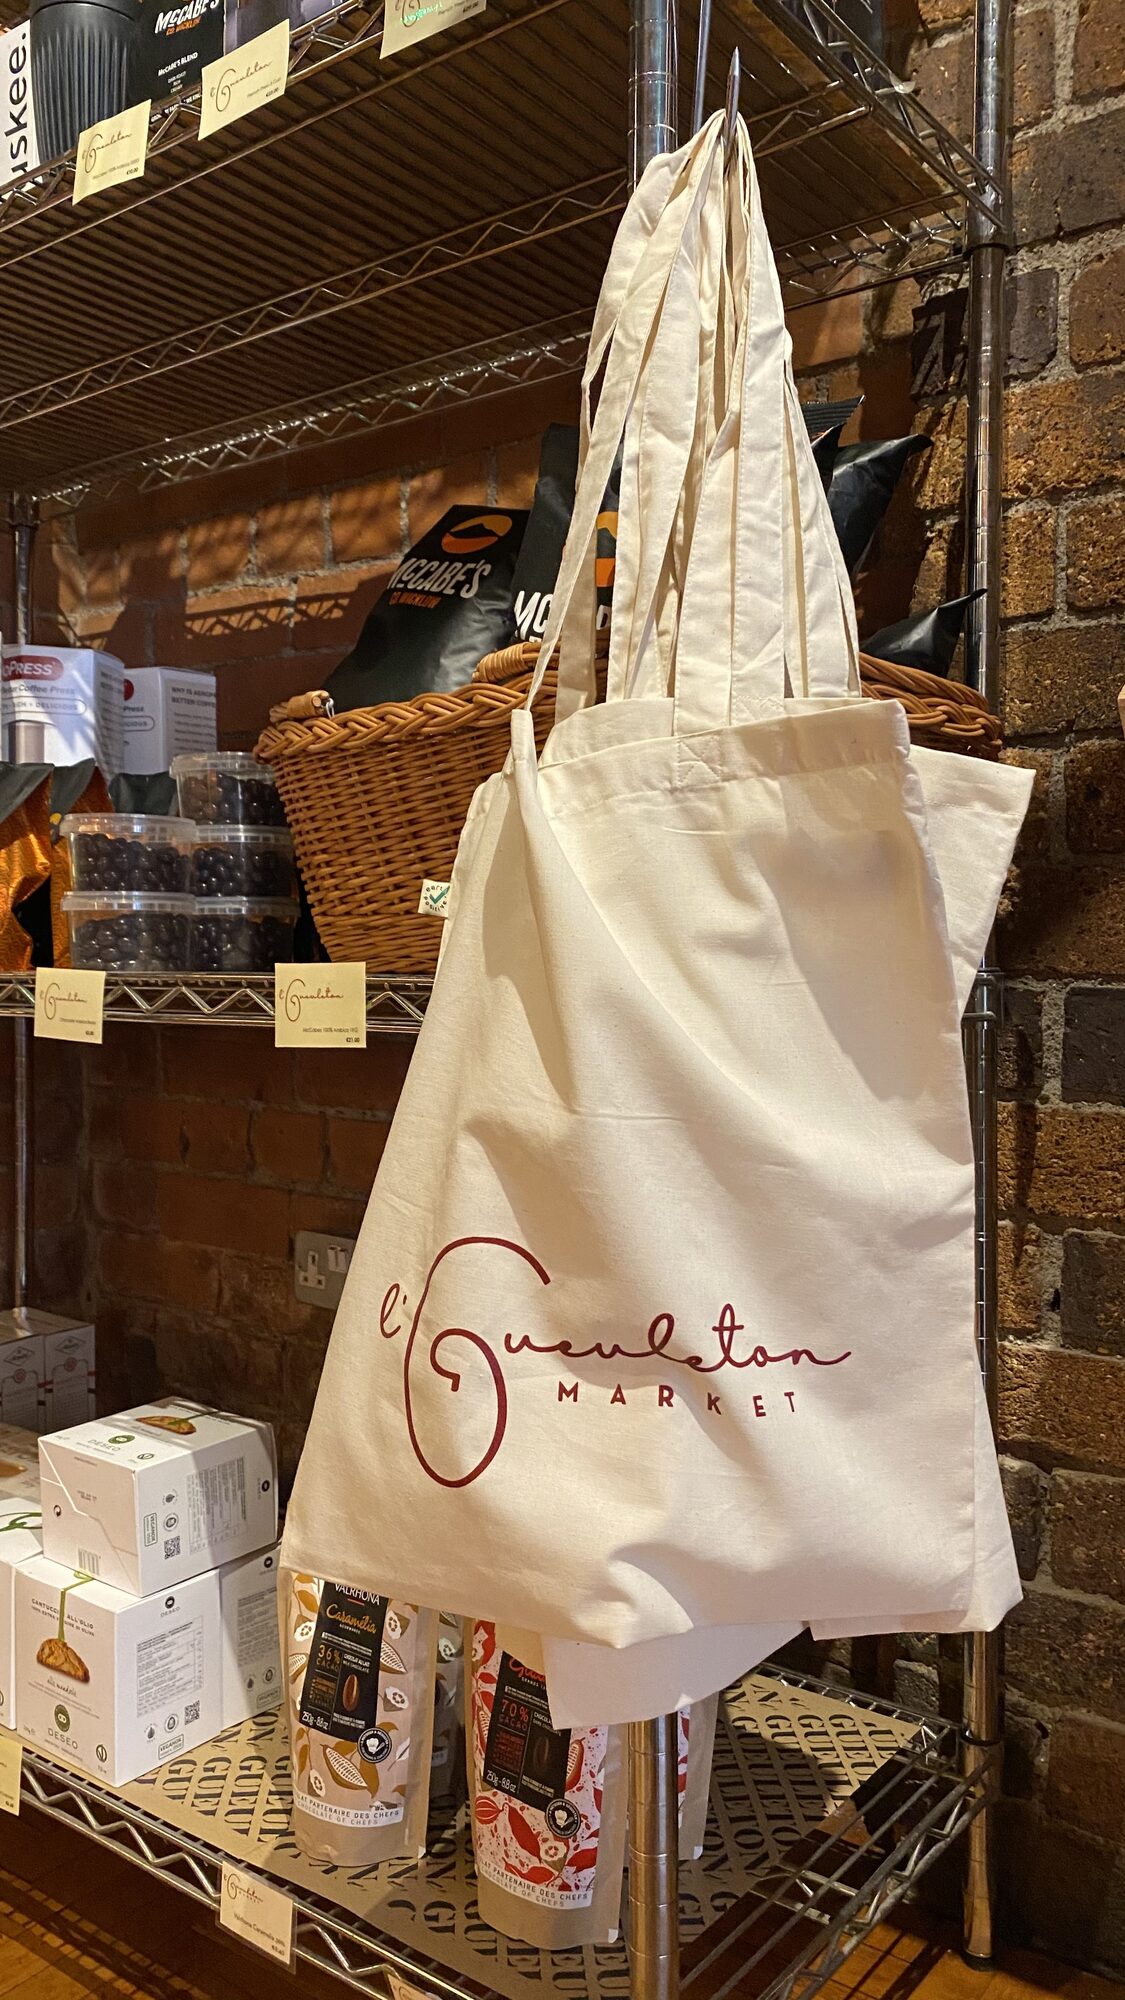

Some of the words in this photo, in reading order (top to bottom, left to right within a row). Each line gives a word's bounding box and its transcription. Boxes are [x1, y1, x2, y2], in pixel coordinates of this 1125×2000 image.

[181, 51, 199, 65] BLEND
[557, 1380, 796, 1418] MARKET
[334, 1583, 381, 1606] VALRHONA
[316, 1657, 340, 1672] CACAO
[498, 1713, 529, 1732] CACAO
[47, 1727, 79, 1751] DESEO
[309, 1797, 351, 1818] PARTENAIRE
[353, 1810, 370, 1820] DES
[373, 1809, 400, 1820] CHEFS
[350, 1816, 379, 1826] CHEFS
[493, 1865, 537, 1893] PARTENAIRE
[539, 1889, 556, 1899] DES
[559, 1893, 588, 1901] CHEFS
[535, 1895, 565, 1907] CHEFS
